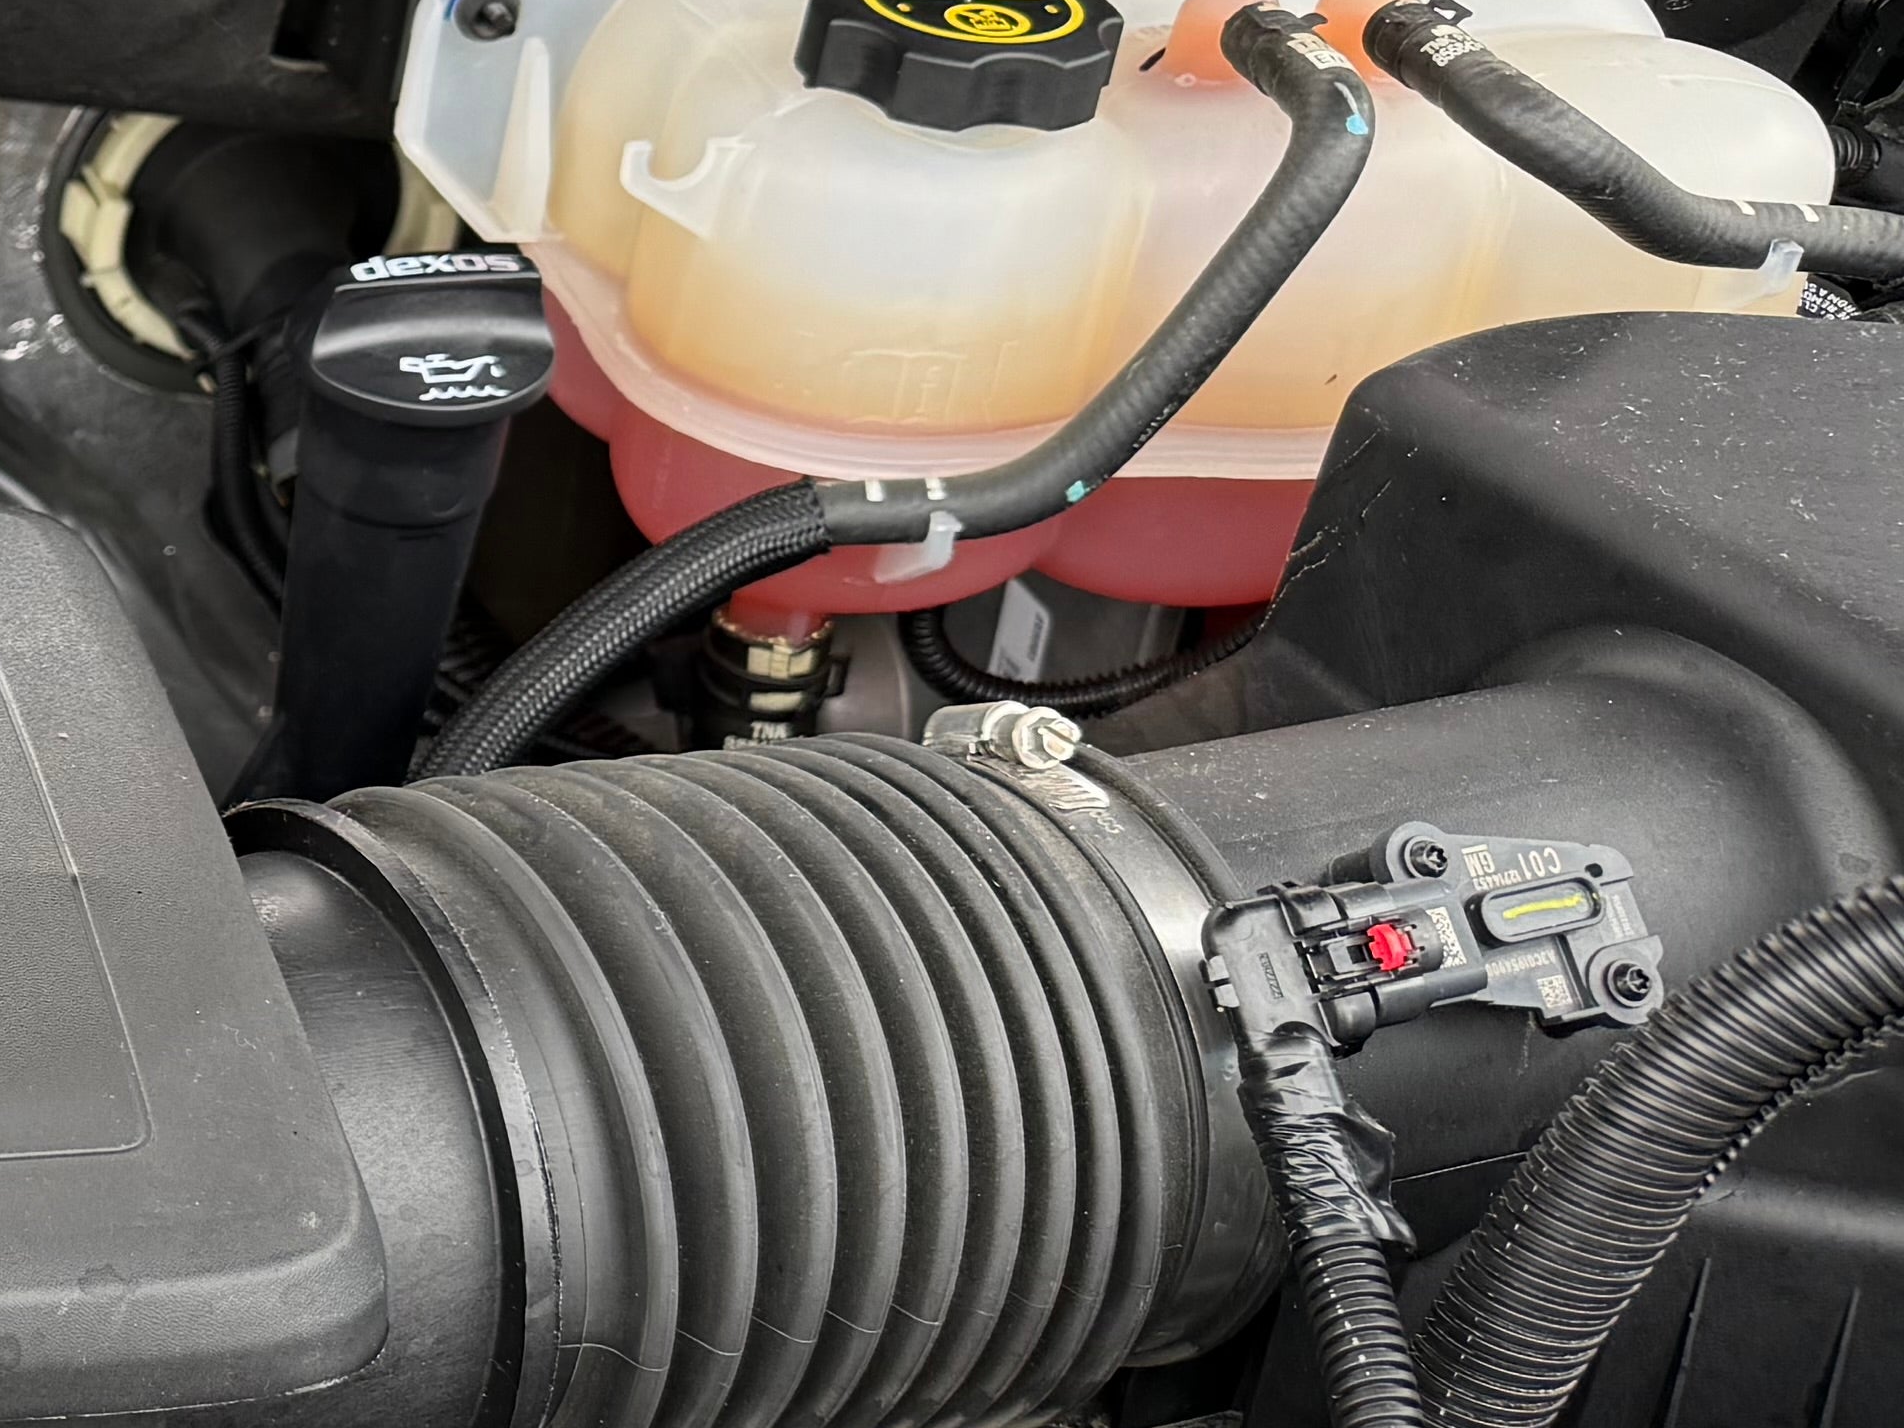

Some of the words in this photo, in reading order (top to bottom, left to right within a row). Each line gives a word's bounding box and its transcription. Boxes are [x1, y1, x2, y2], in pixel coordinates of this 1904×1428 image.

[350, 254, 520, 282] dexos
[1462, 849, 1496, 877] GM
[1517, 847, 1561, 881] C01
